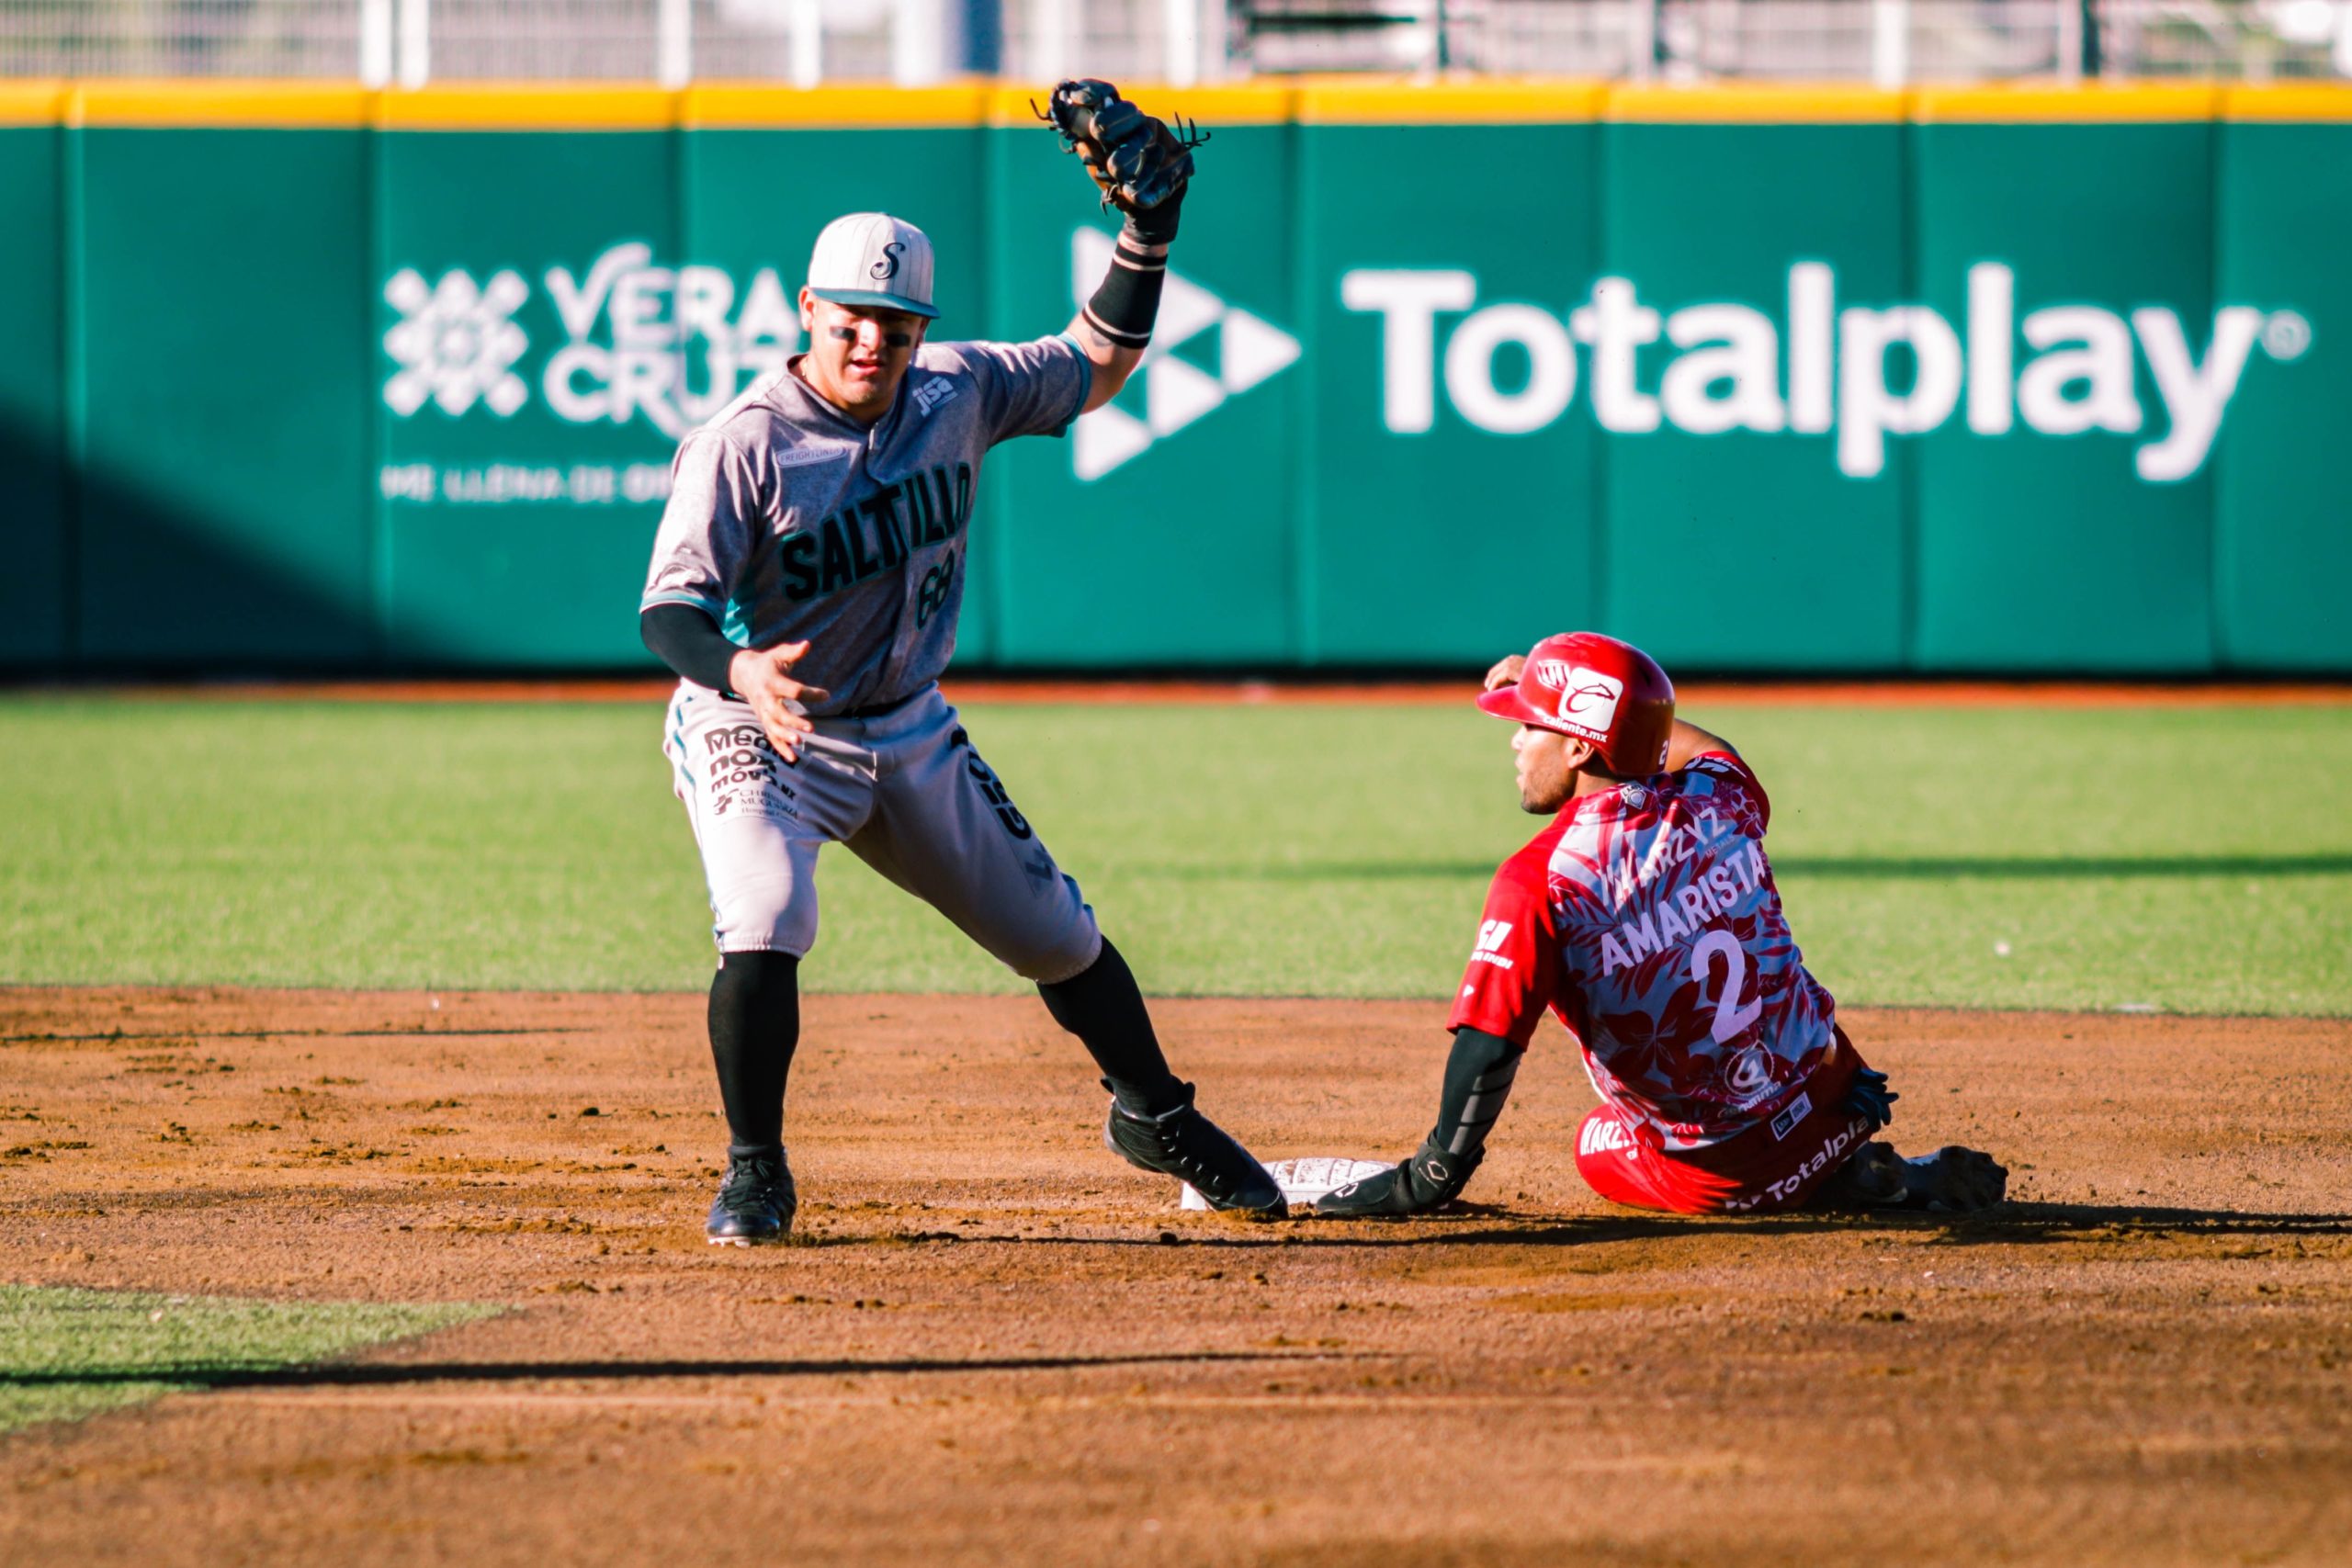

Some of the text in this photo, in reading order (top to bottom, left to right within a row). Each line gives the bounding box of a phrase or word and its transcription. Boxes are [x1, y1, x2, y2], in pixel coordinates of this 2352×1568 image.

[544, 241, 801, 345] VERA
[870, 242, 906, 280] S
[1340, 260, 2265, 482] Totalplay
[779, 461, 971, 604] SALTILLO
[1543, 715, 1609, 743] caliente.mx
[1658, 739, 1669, 765] 2
[1600, 840, 1767, 977] AMARISTA
[1690, 930, 1762, 1045] 2
[1765, 1115, 1870, 1202] Totalpla
